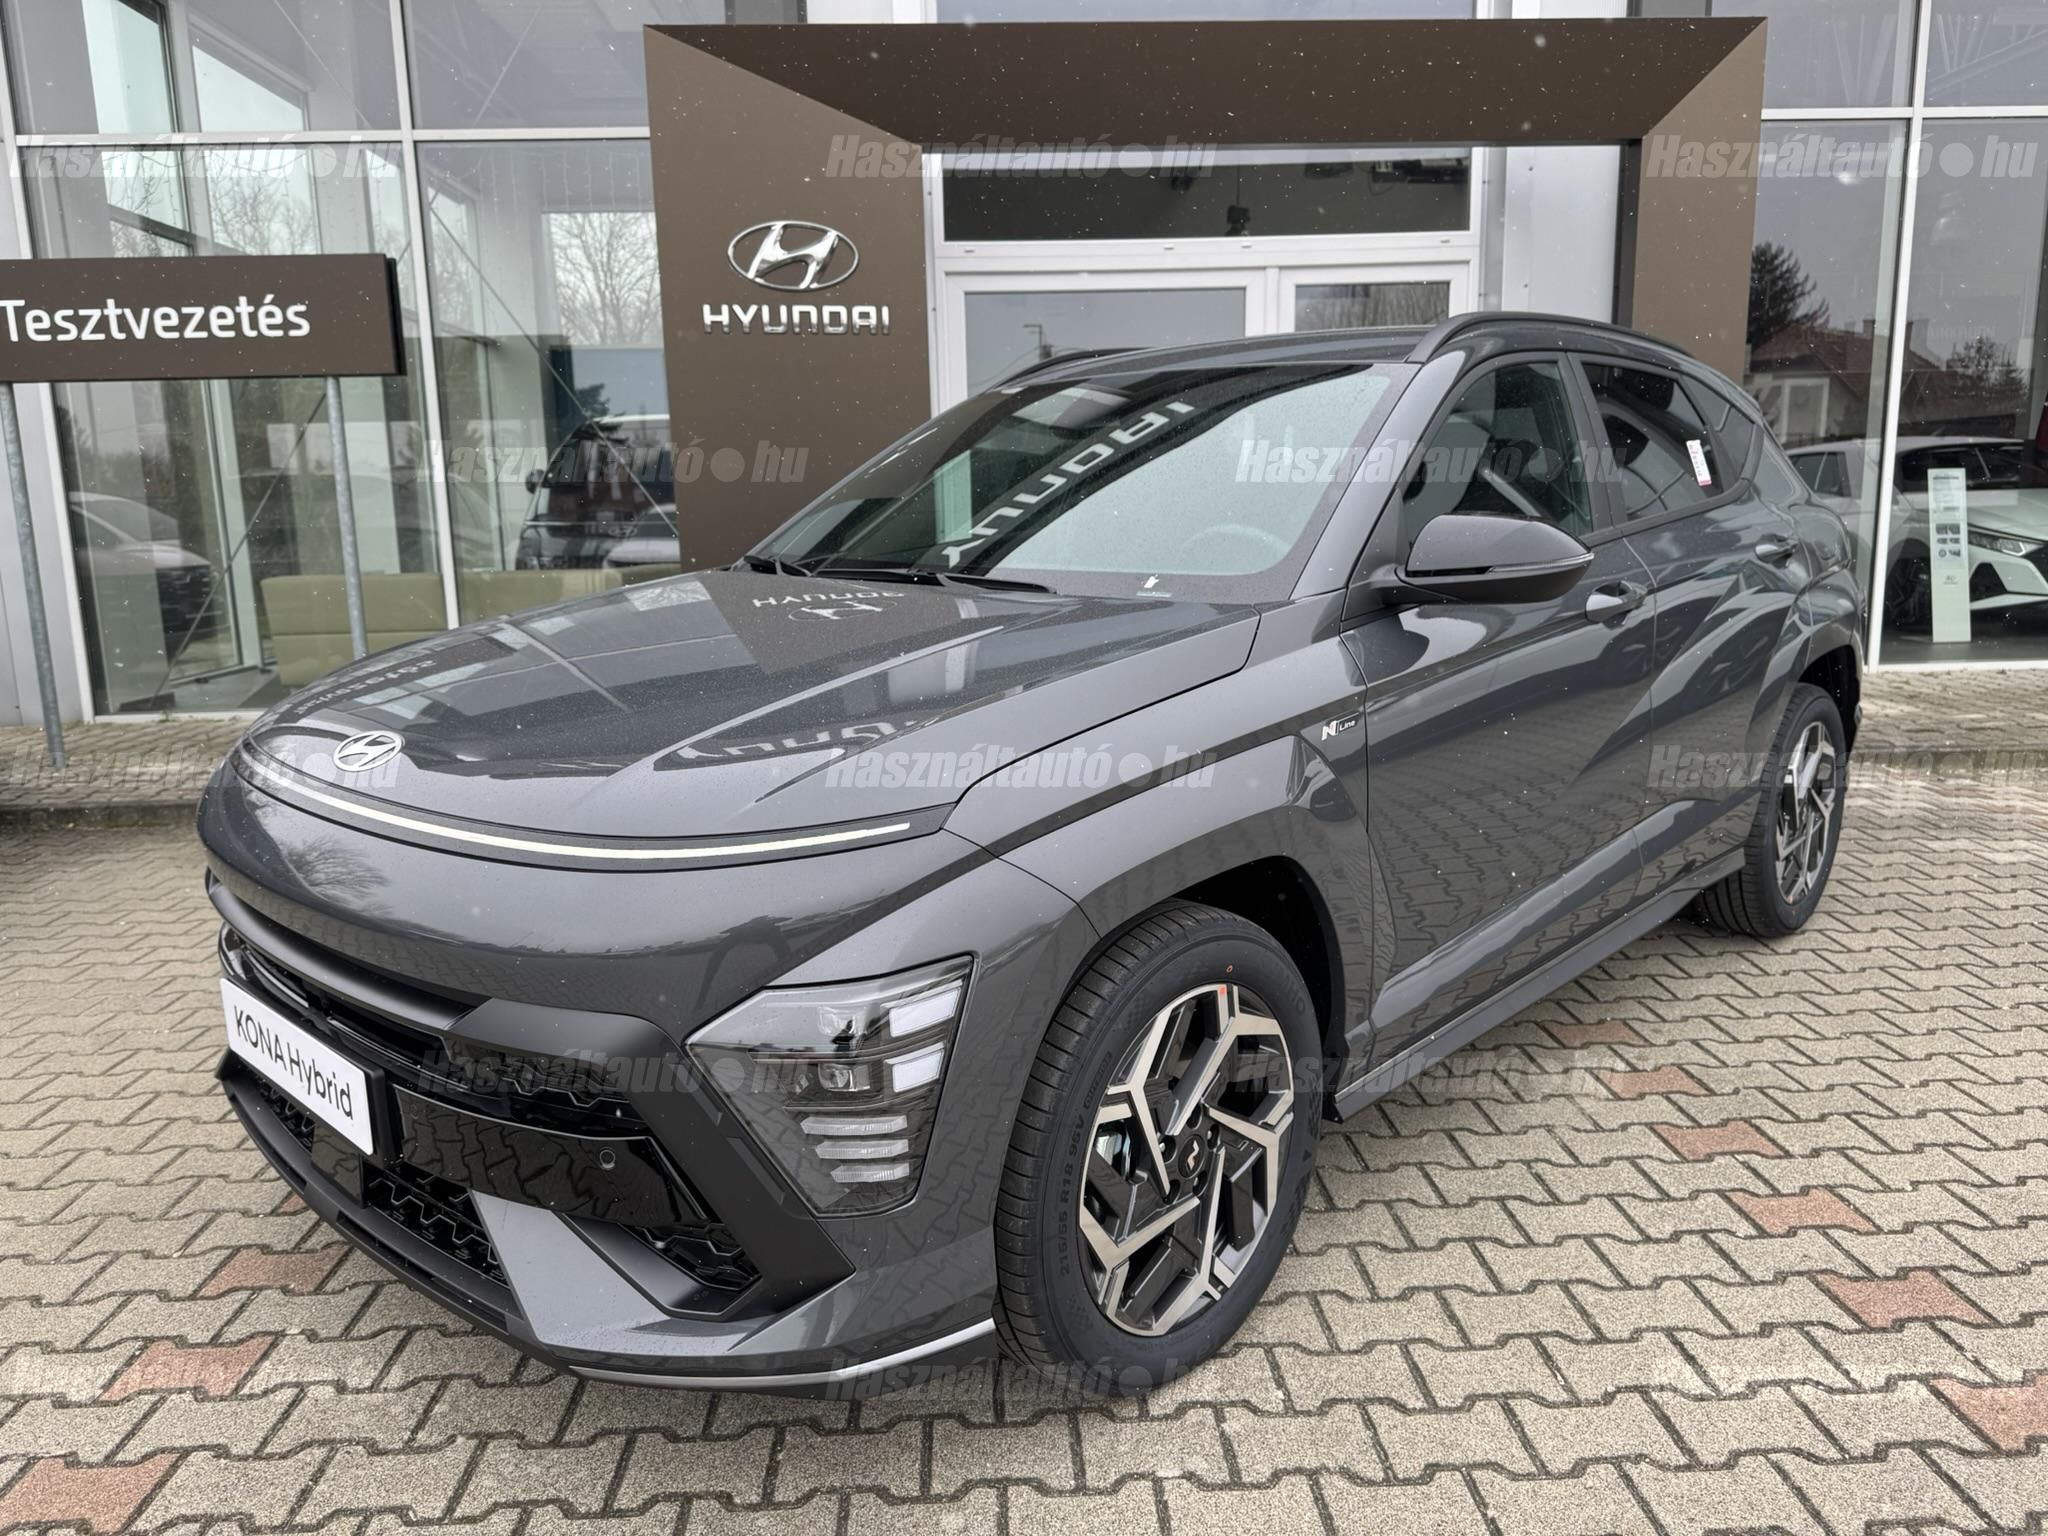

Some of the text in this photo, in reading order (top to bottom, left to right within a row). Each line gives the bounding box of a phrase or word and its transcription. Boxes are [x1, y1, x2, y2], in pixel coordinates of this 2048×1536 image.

[0, 294, 310, 342] Tesztvezetés
[703, 304, 890, 335] HYUNDAI
[234, 1005, 354, 1121] KONA Hybrid
[1060, 1163, 1074, 1210] R18
[1058, 1211, 1070, 1277] 215/55
